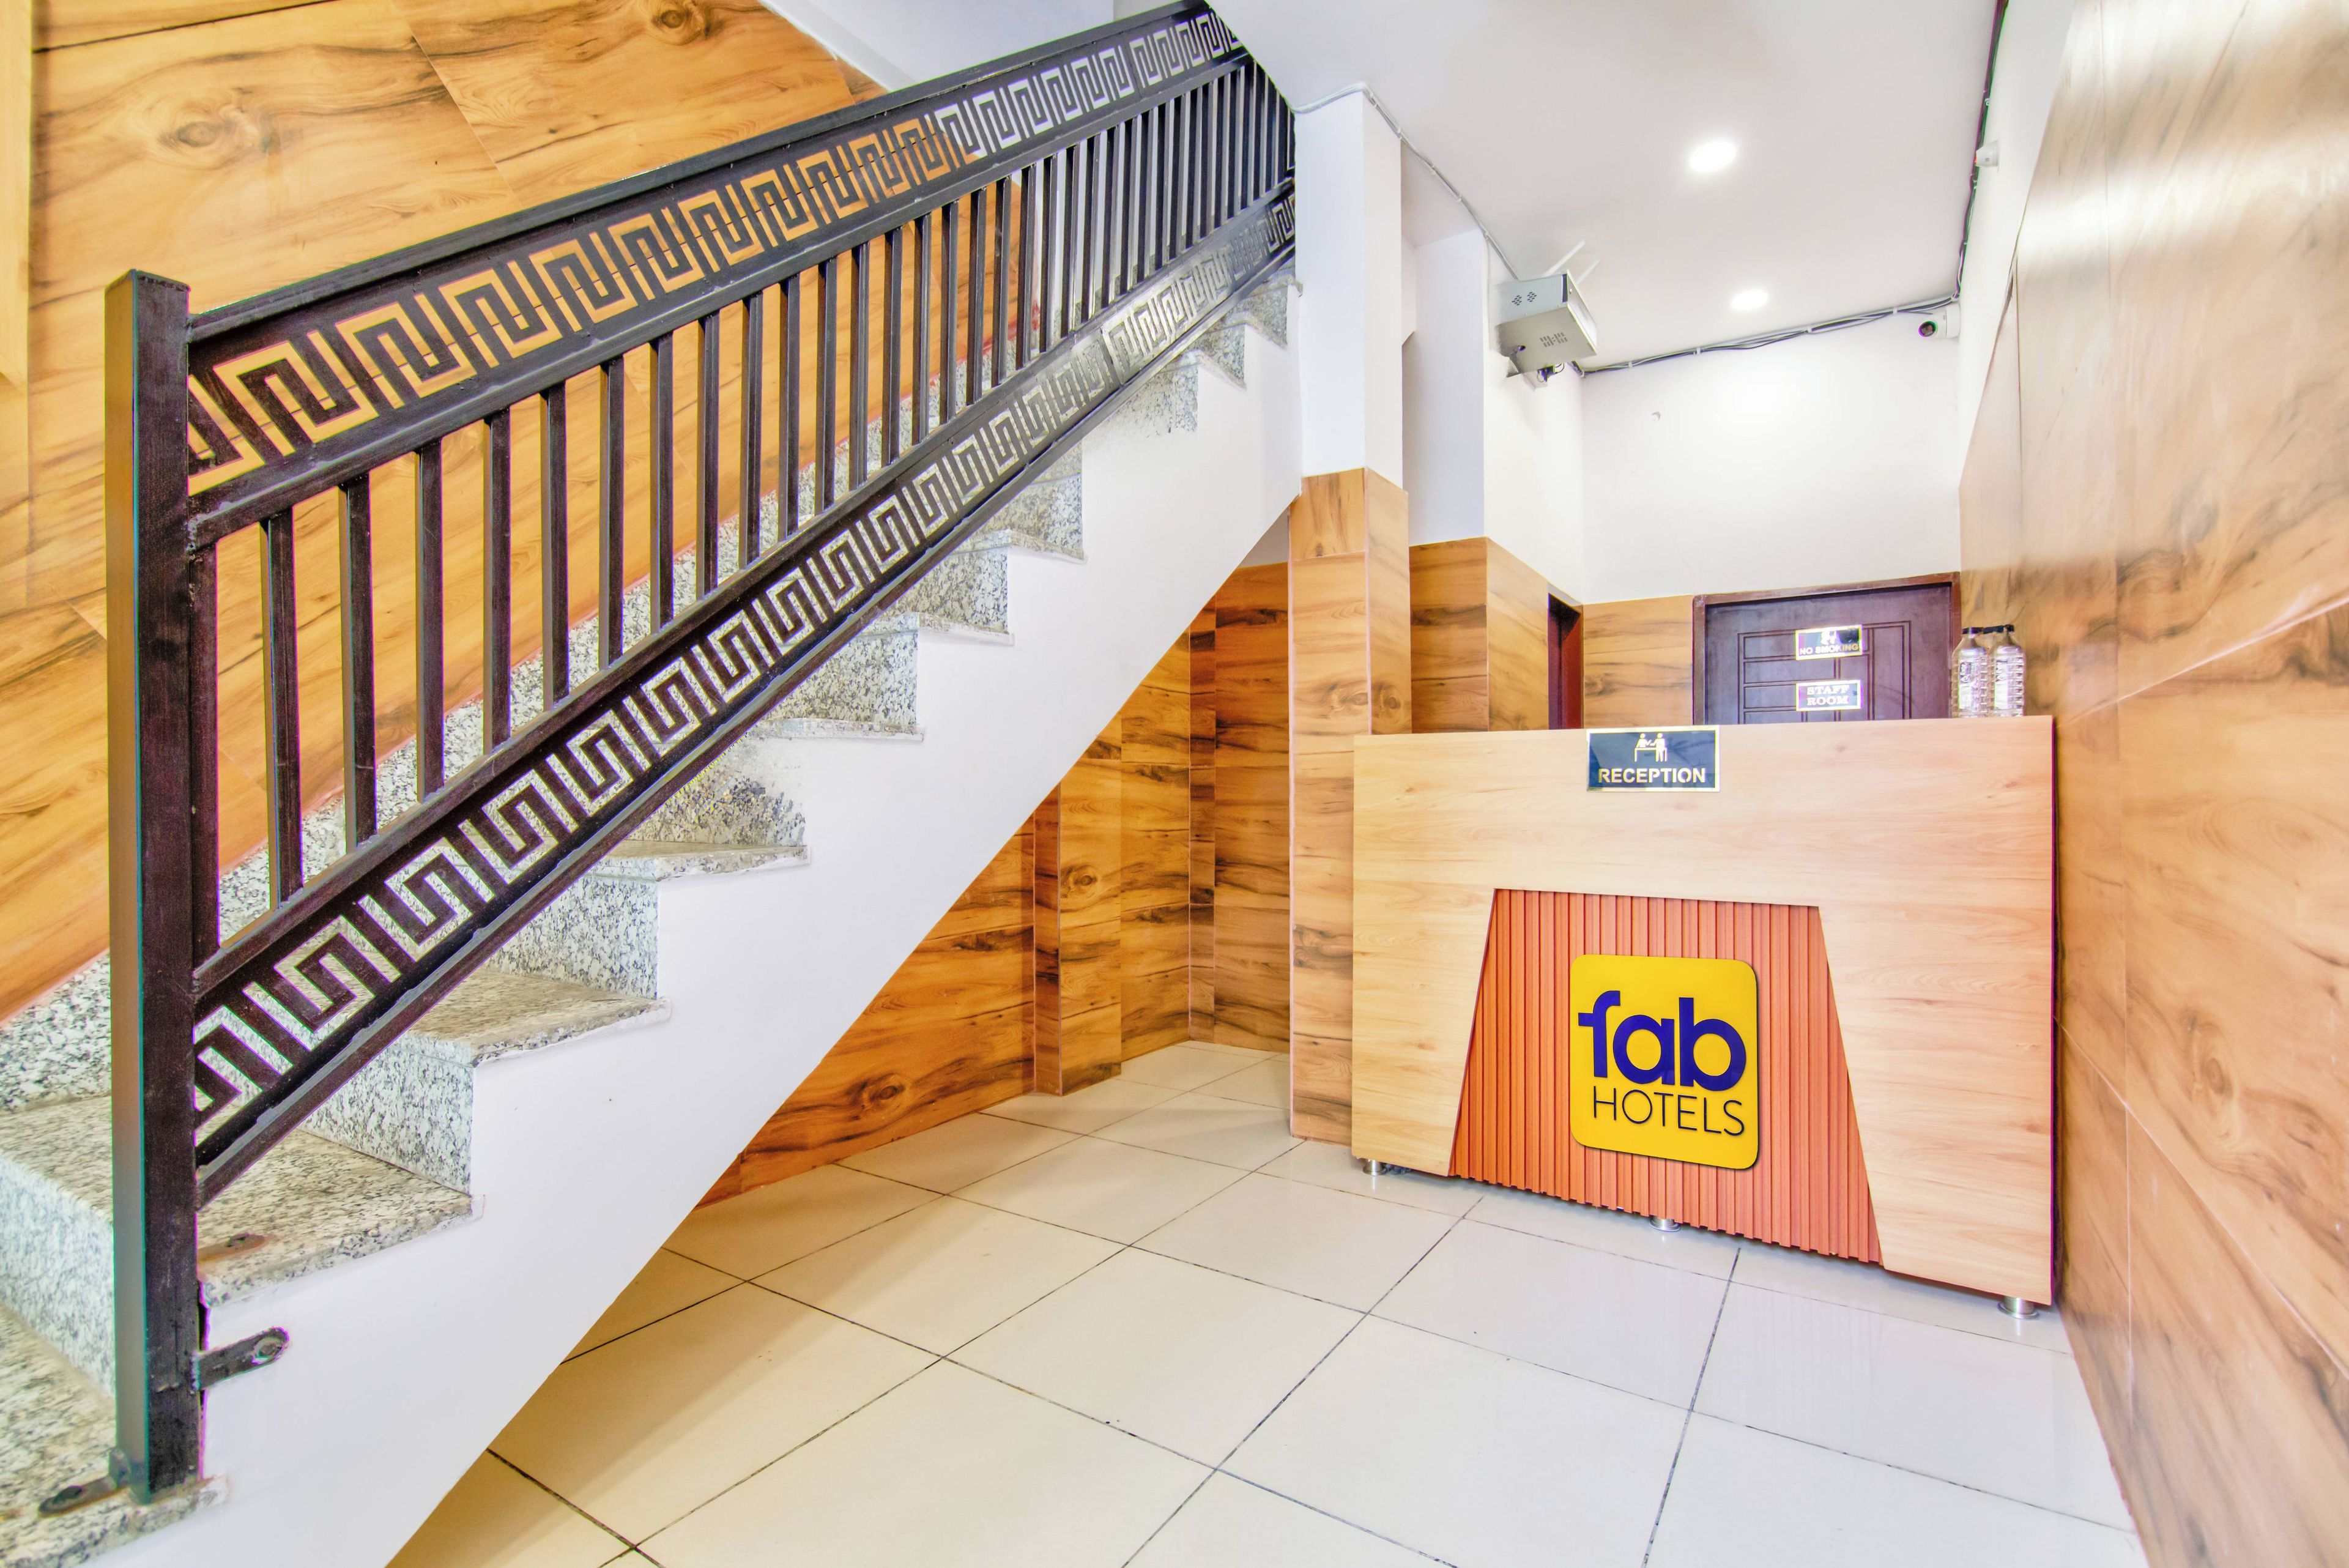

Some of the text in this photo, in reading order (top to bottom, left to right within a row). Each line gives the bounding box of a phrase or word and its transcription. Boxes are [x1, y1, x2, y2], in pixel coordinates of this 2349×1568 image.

[1816, 644, 1858, 654] SMOKING
[1807, 685, 1849, 695] STAFF
[1807, 696, 1849, 705] ROOM
[1598, 768, 1705, 783] RECEPTION
[1578, 990, 1746, 1091] fab
[1593, 1085, 1745, 1136] HOTELS
